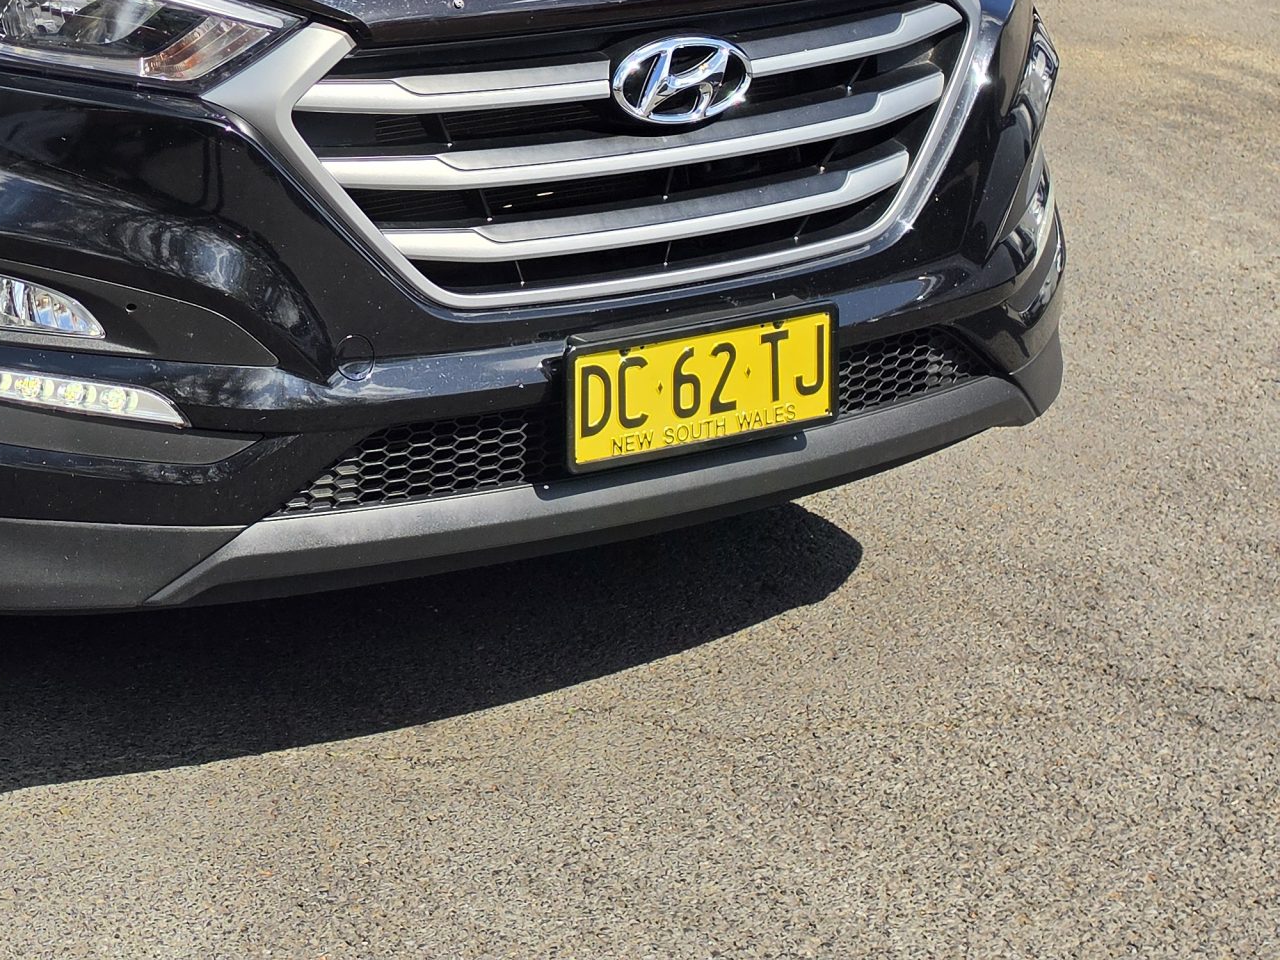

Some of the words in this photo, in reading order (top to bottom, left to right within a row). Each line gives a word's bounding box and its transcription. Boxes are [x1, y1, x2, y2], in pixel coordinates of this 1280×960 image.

[581, 354, 648, 438] DC
[672, 342, 737, 419] 62
[761, 324, 825, 402] TJ
[611, 430, 654, 456] NEW
[663, 419, 726, 446] SOUTH
[735, 404, 796, 431] WALES
